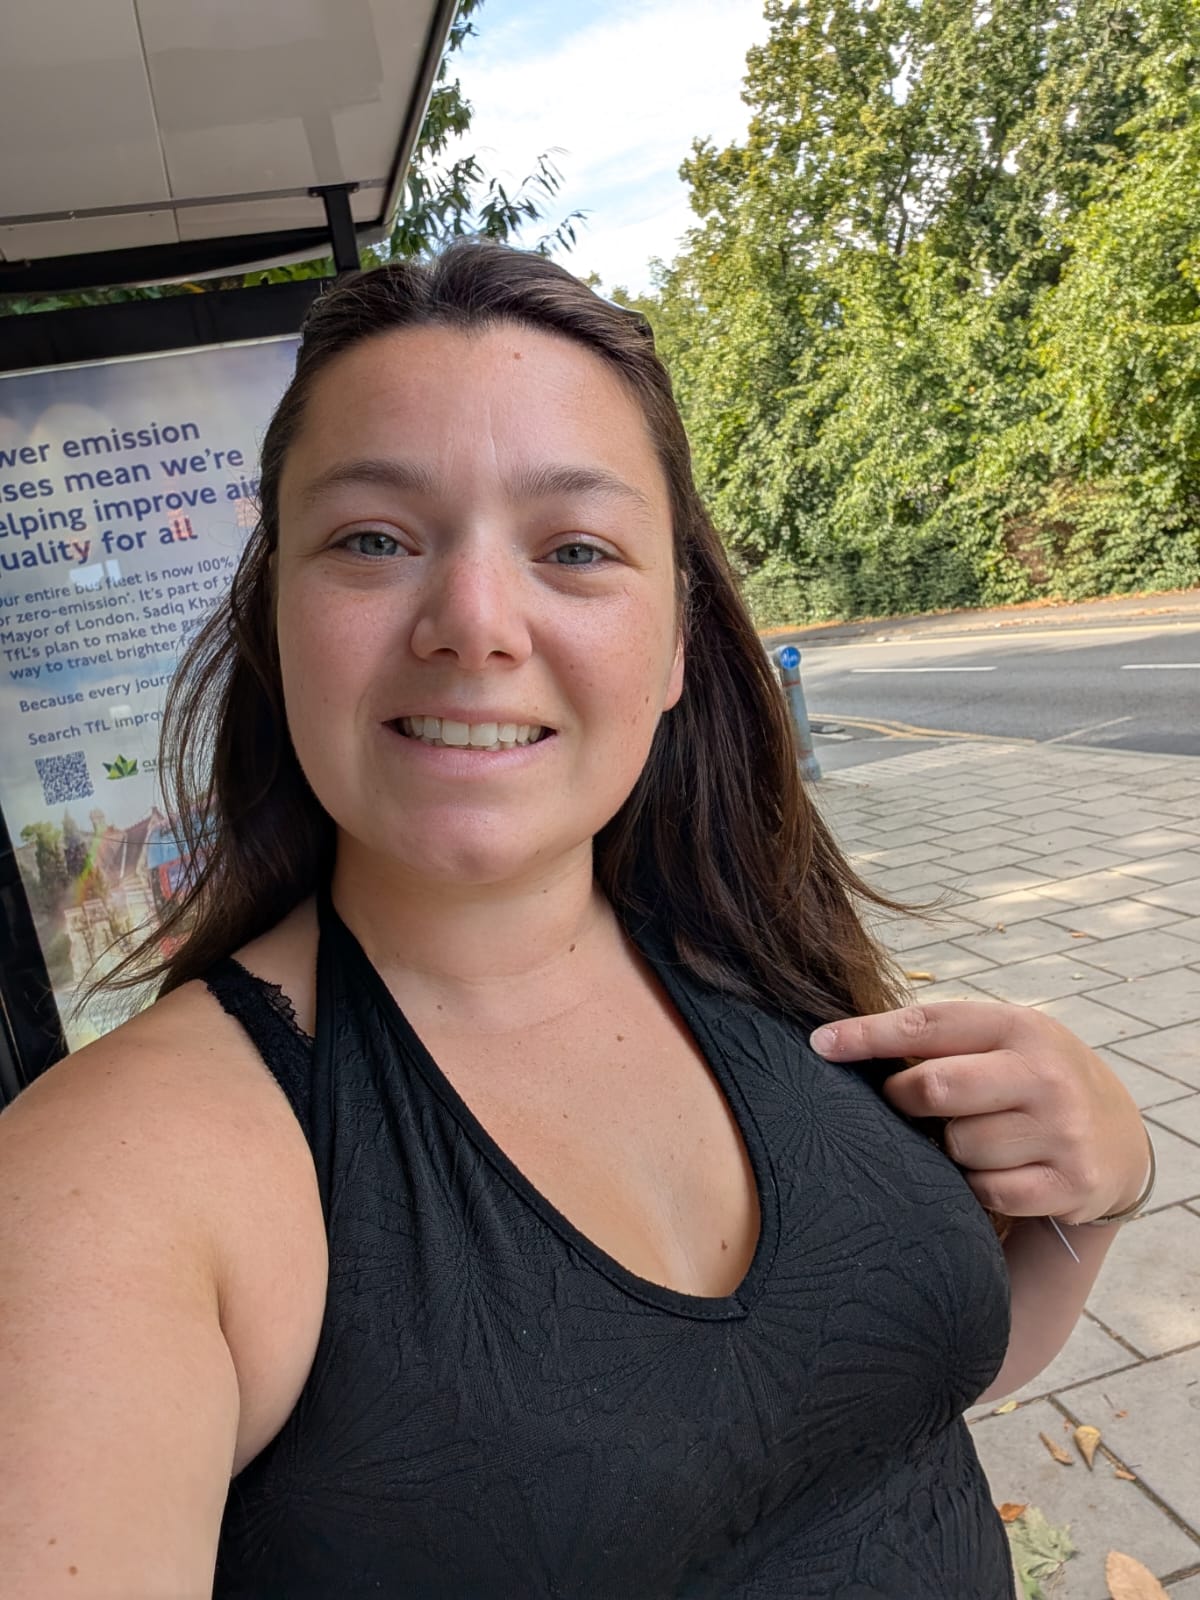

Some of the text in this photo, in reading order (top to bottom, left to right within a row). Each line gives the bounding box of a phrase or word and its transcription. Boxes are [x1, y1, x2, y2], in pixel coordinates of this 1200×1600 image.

[63, 421, 200, 458] emission
[0, 448, 244, 503] ses mean we're
[94, 487, 217, 522] improve
[0, 517, 199, 578] uality for all
[24, 586, 71, 604] entire
[75, 581, 103, 595] bus
[105, 573, 143, 590] fleet
[145, 570, 158, 583] is
[162, 565, 193, 580] now
[198, 555, 234, 573] 100%
[139, 587, 163, 602] It's
[168, 581, 200, 599] part
[203, 575, 219, 590] of
[0, 626, 49, 645] Mayor
[54, 620, 71, 635] of
[142, 602, 185, 619] Sadiq
[3, 646, 40, 662] TfL's
[44, 640, 79, 659] plan
[83, 636, 101, 648] to
[105, 627, 147, 644] make
[151, 622, 177, 635] the
[9, 665, 41, 680] way
[46, 661, 63, 673] to
[67, 650, 113, 669] travel
[116, 638, 176, 661] brighter
[19, 691, 85, 713] Because
[88, 682, 131, 701] every
[28, 724, 81, 746] Search
[84, 719, 111, 735] TfL
